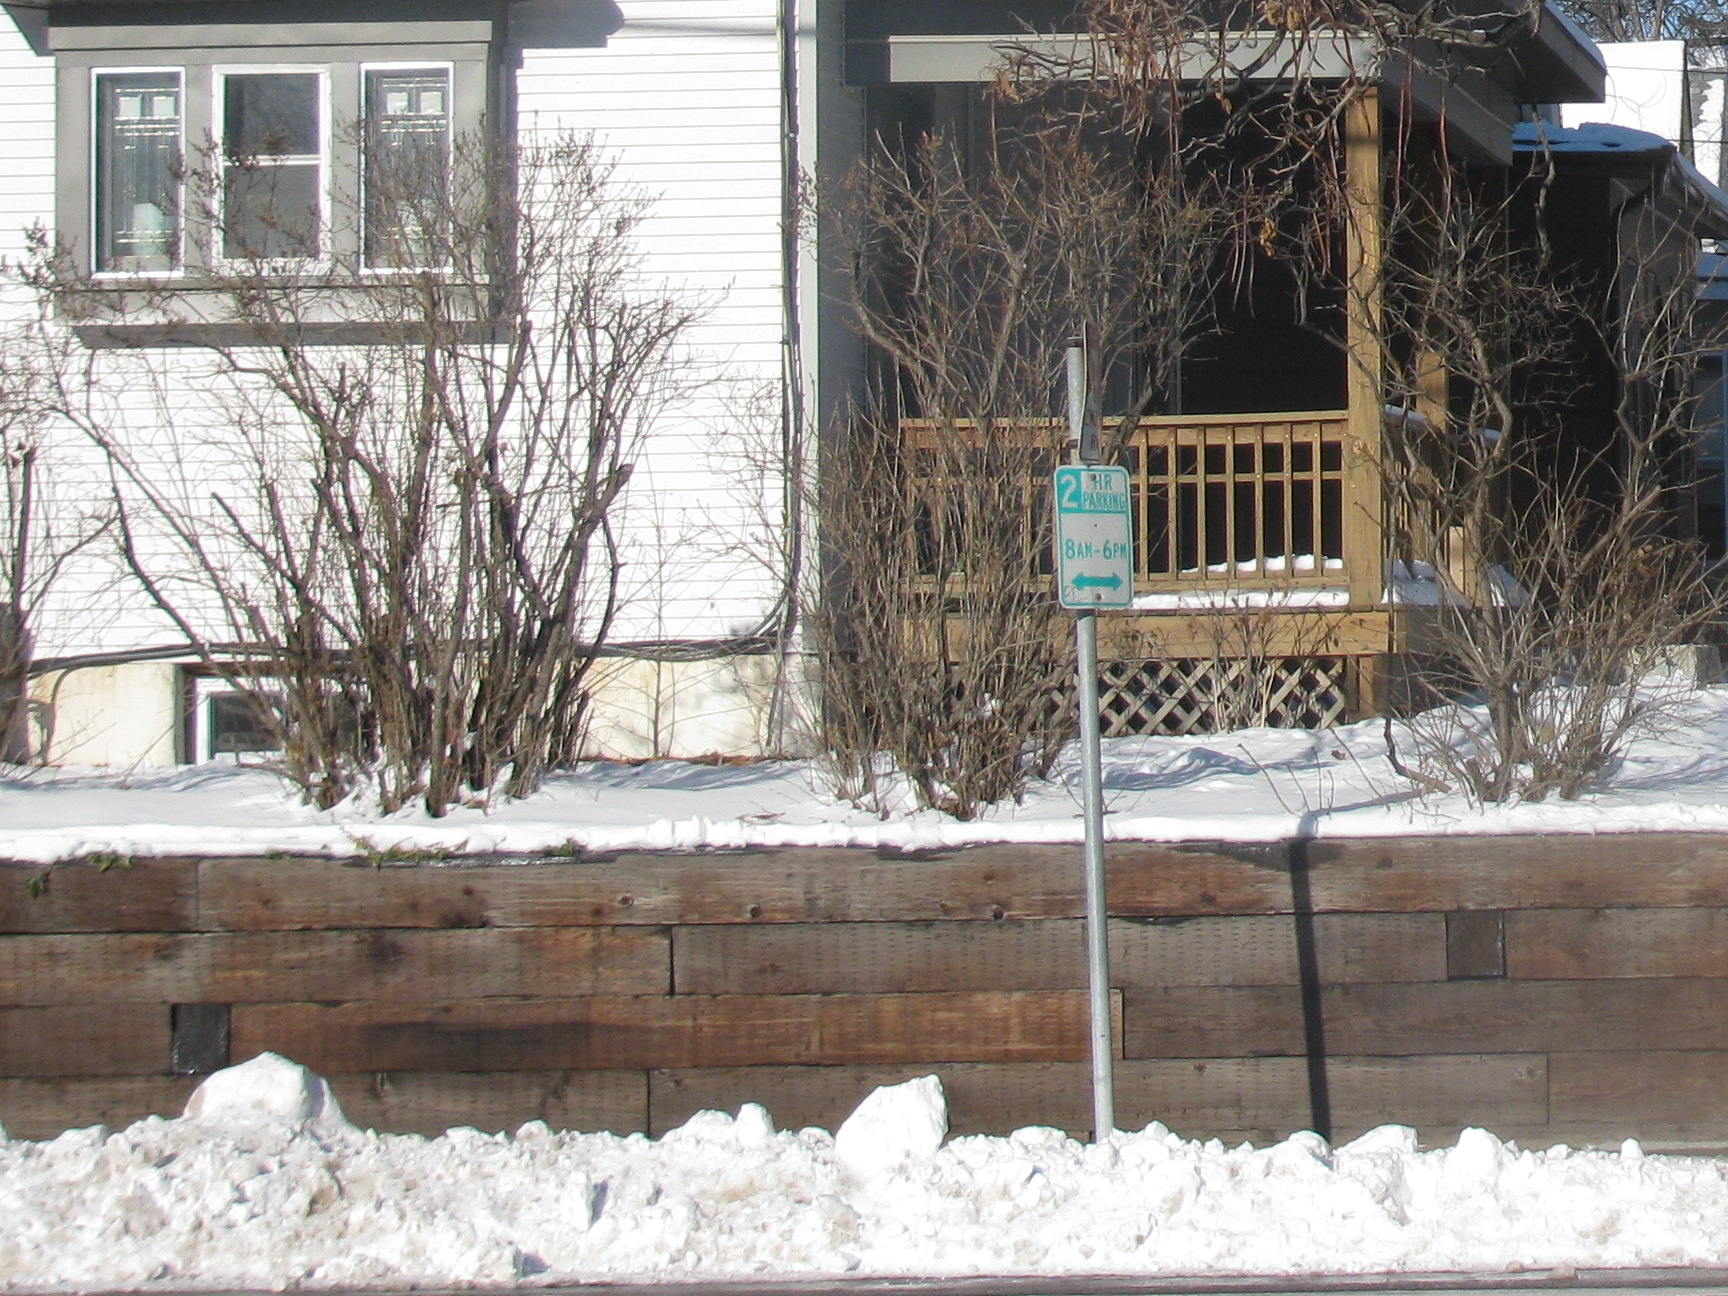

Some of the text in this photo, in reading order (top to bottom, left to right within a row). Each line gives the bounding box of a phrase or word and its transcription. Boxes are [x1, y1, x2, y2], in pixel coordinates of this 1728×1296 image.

[1060, 474, 1113, 508] 2 HR
[1083, 492, 1127, 510] PARKING
